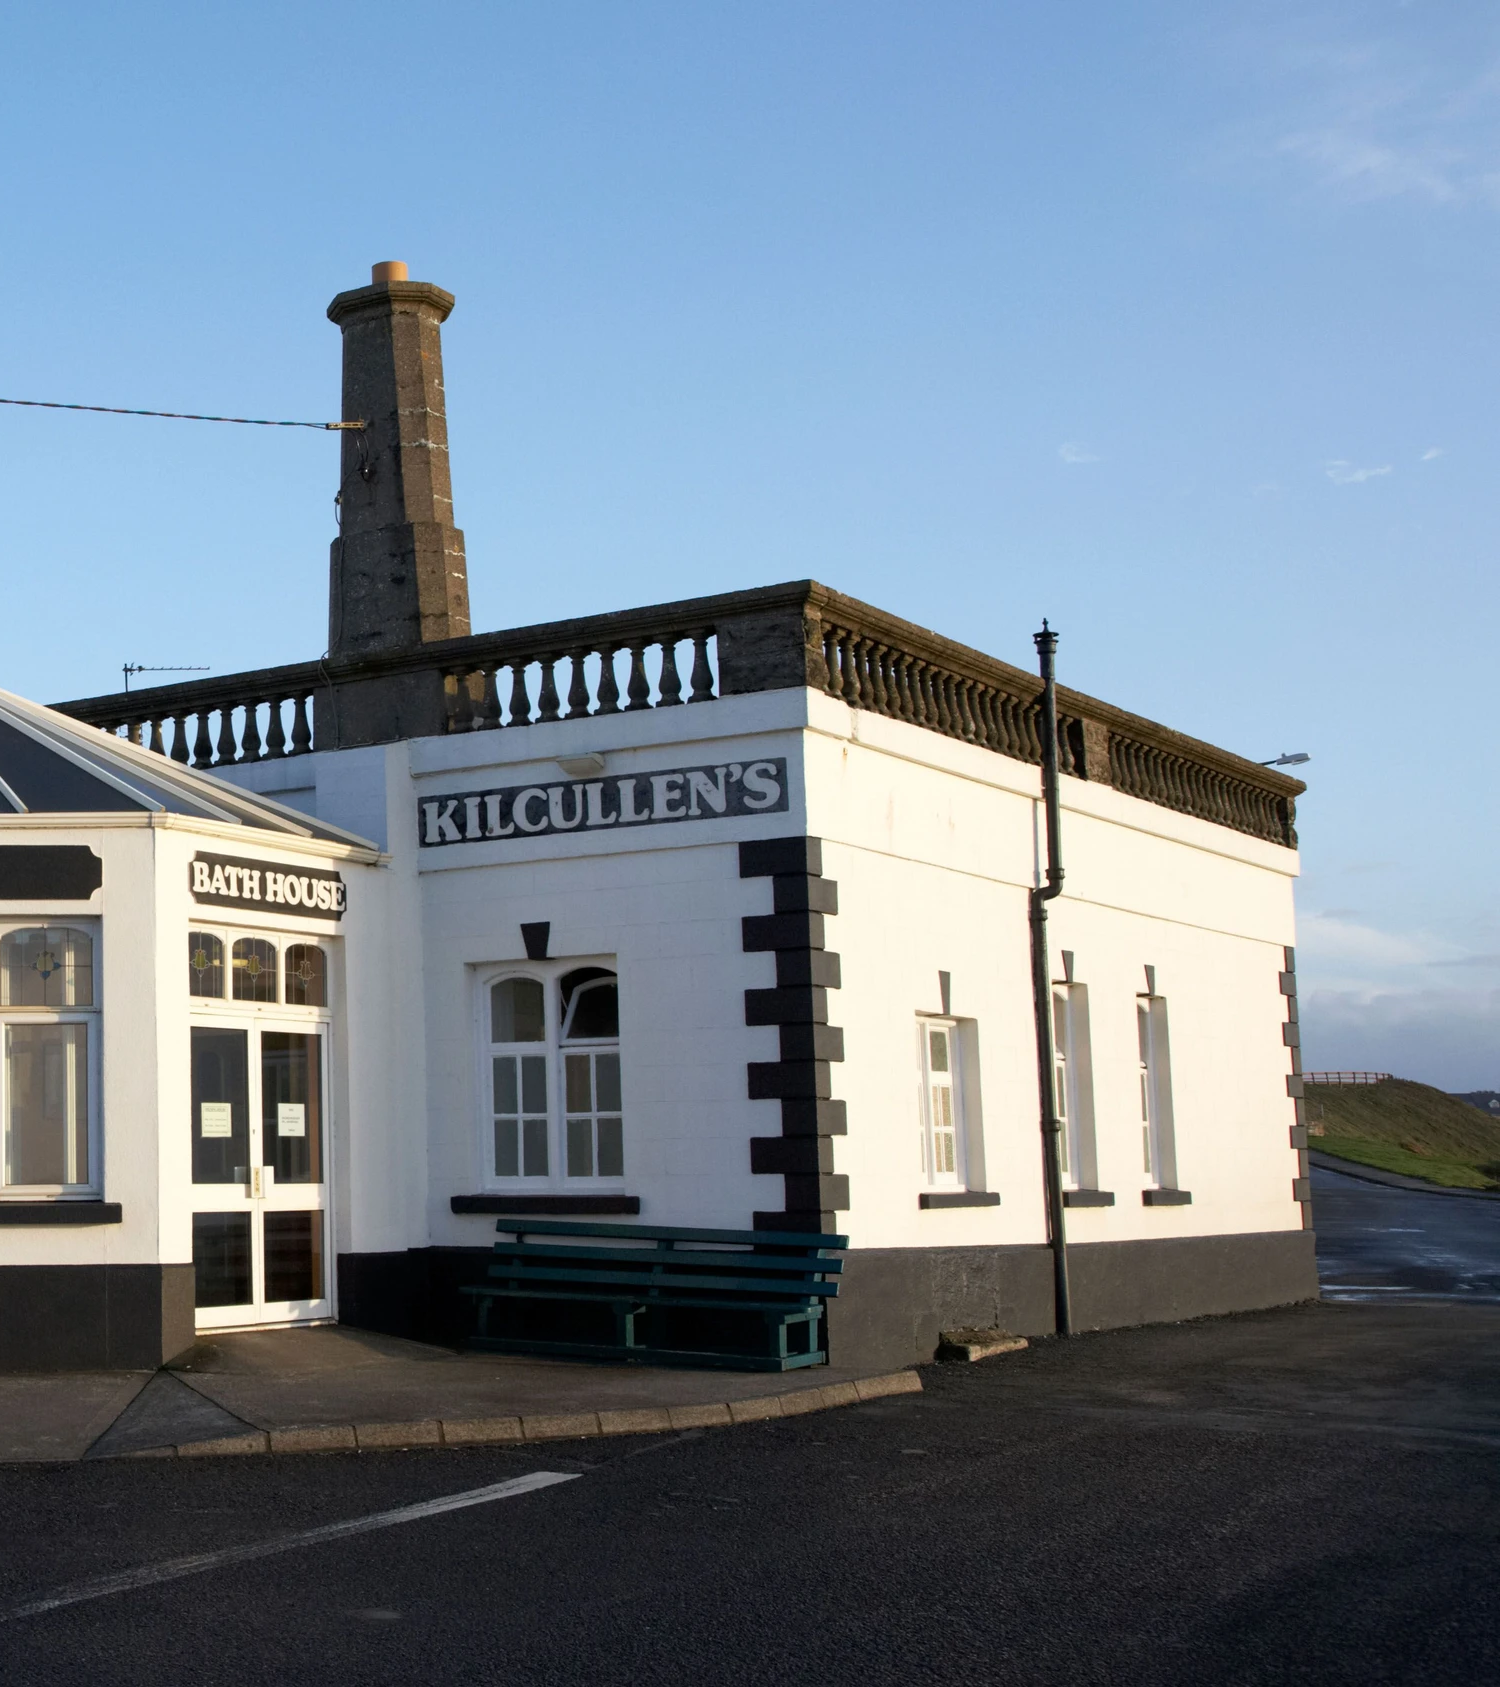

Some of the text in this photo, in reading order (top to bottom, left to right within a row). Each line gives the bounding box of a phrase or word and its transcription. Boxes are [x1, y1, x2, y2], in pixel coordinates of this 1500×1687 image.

[423, 762, 781, 843] KILCULLEN'S
[192, 861, 345, 911] BATH HOUSE
